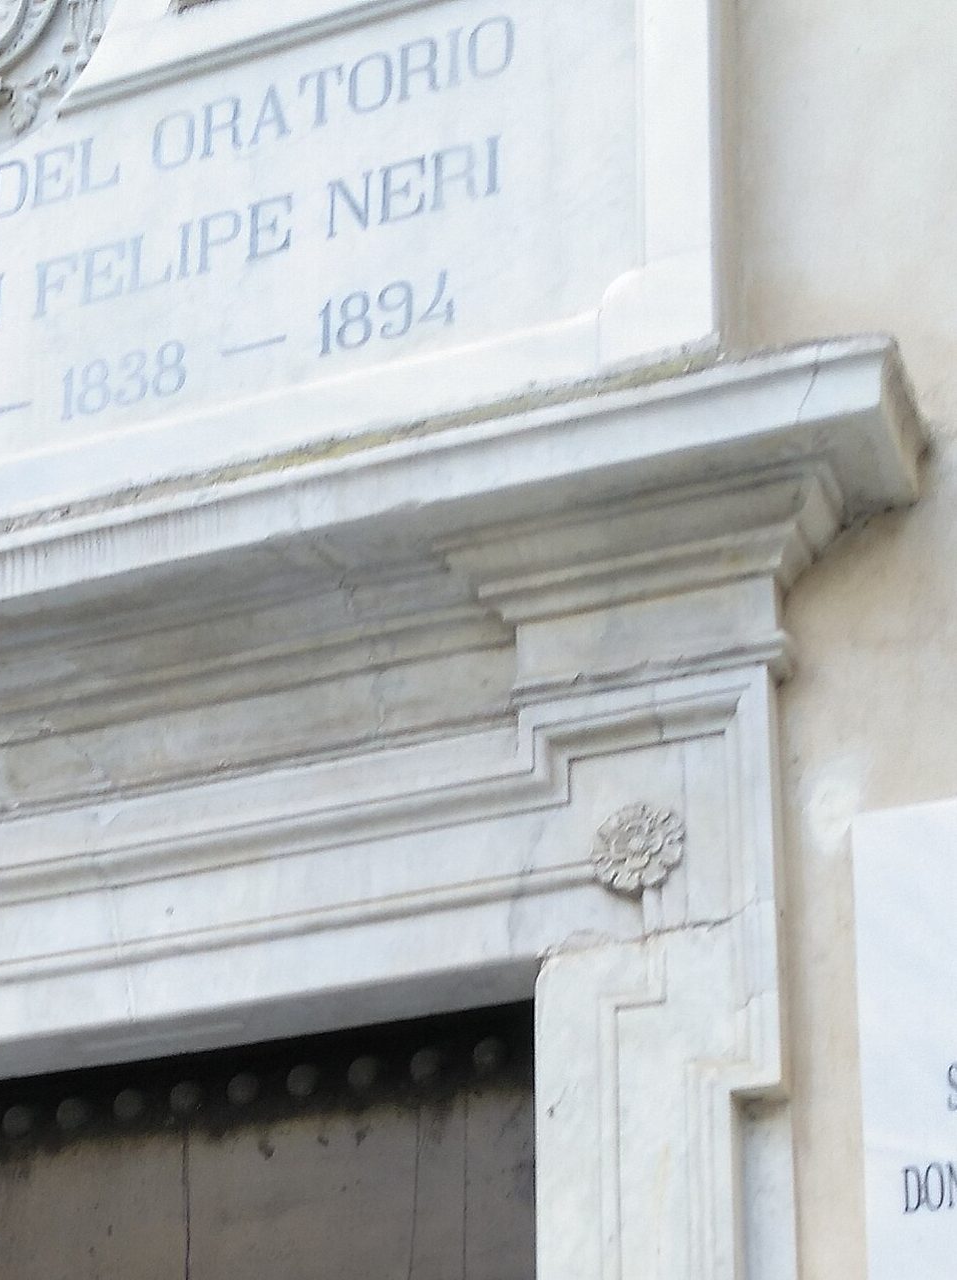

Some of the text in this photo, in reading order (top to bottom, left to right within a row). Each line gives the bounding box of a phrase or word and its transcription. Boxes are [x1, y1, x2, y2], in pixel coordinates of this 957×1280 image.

[151, 15, 516, 171] ORATORIO
[33, 192, 292, 320] FELIPE
[326, 135, 501, 239] NERI
[60, 339, 187, 422] 1838
[318, 268, 455, 358] 1894
